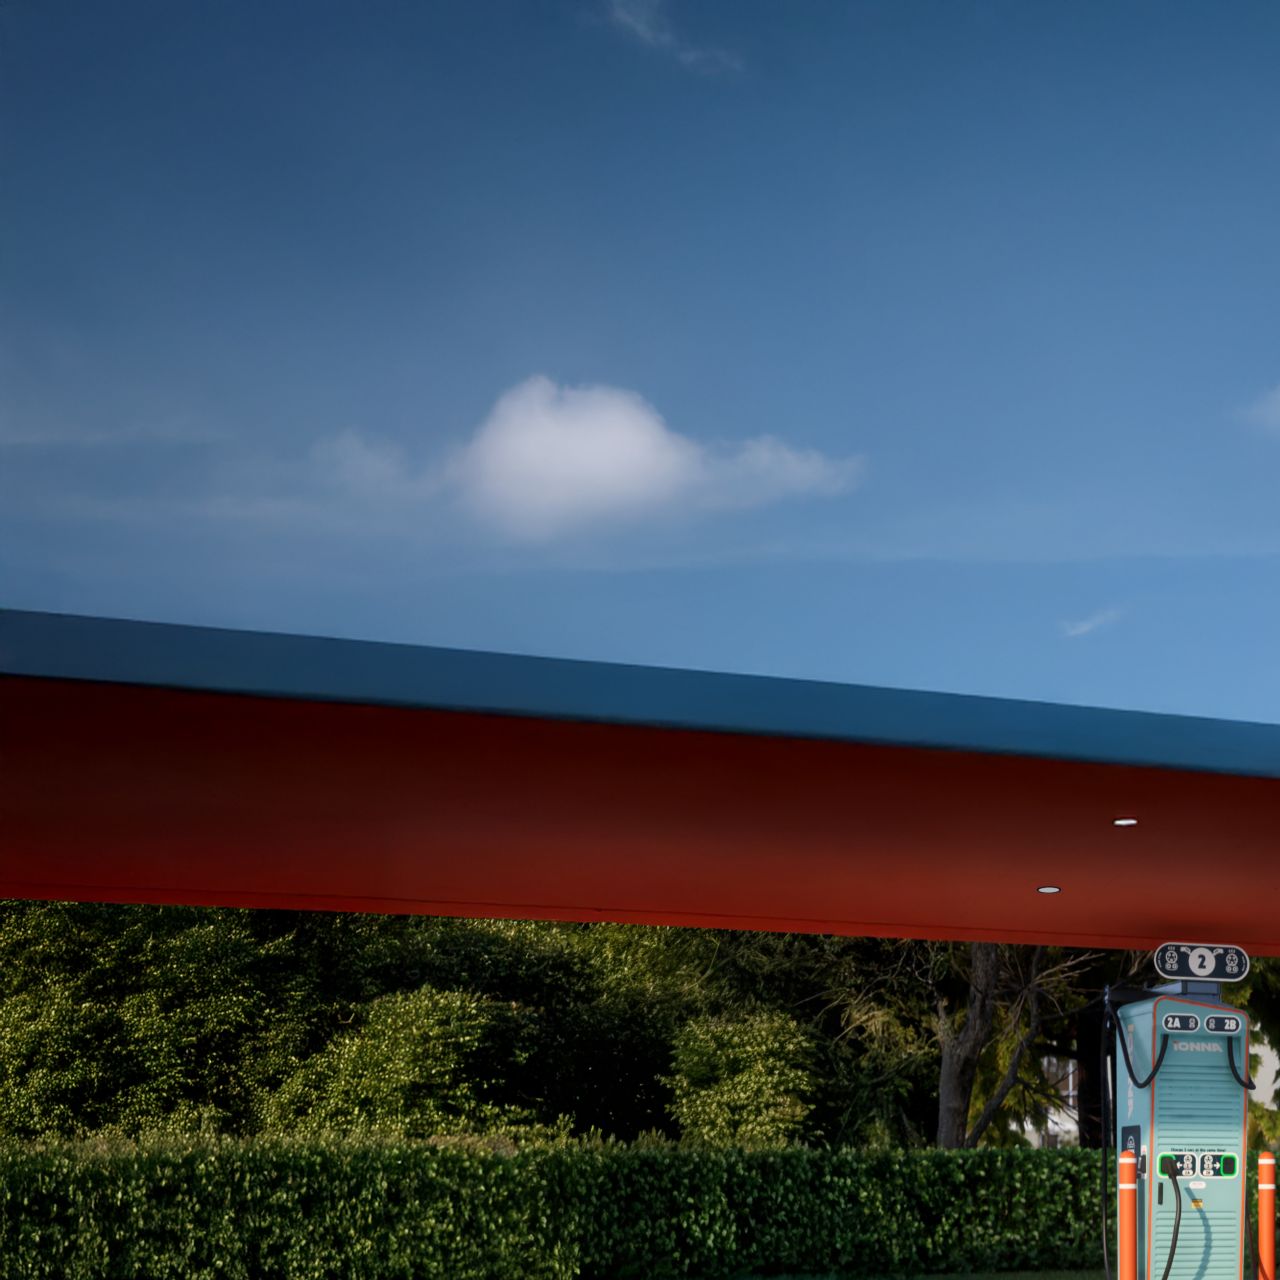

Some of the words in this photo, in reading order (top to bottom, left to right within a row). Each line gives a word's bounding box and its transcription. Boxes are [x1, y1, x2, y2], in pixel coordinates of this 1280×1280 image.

[1197, 954, 1206, 969] 2
[1167, 1017, 1181, 1029] 2A
[1224, 1019, 1237, 1030] 2B
